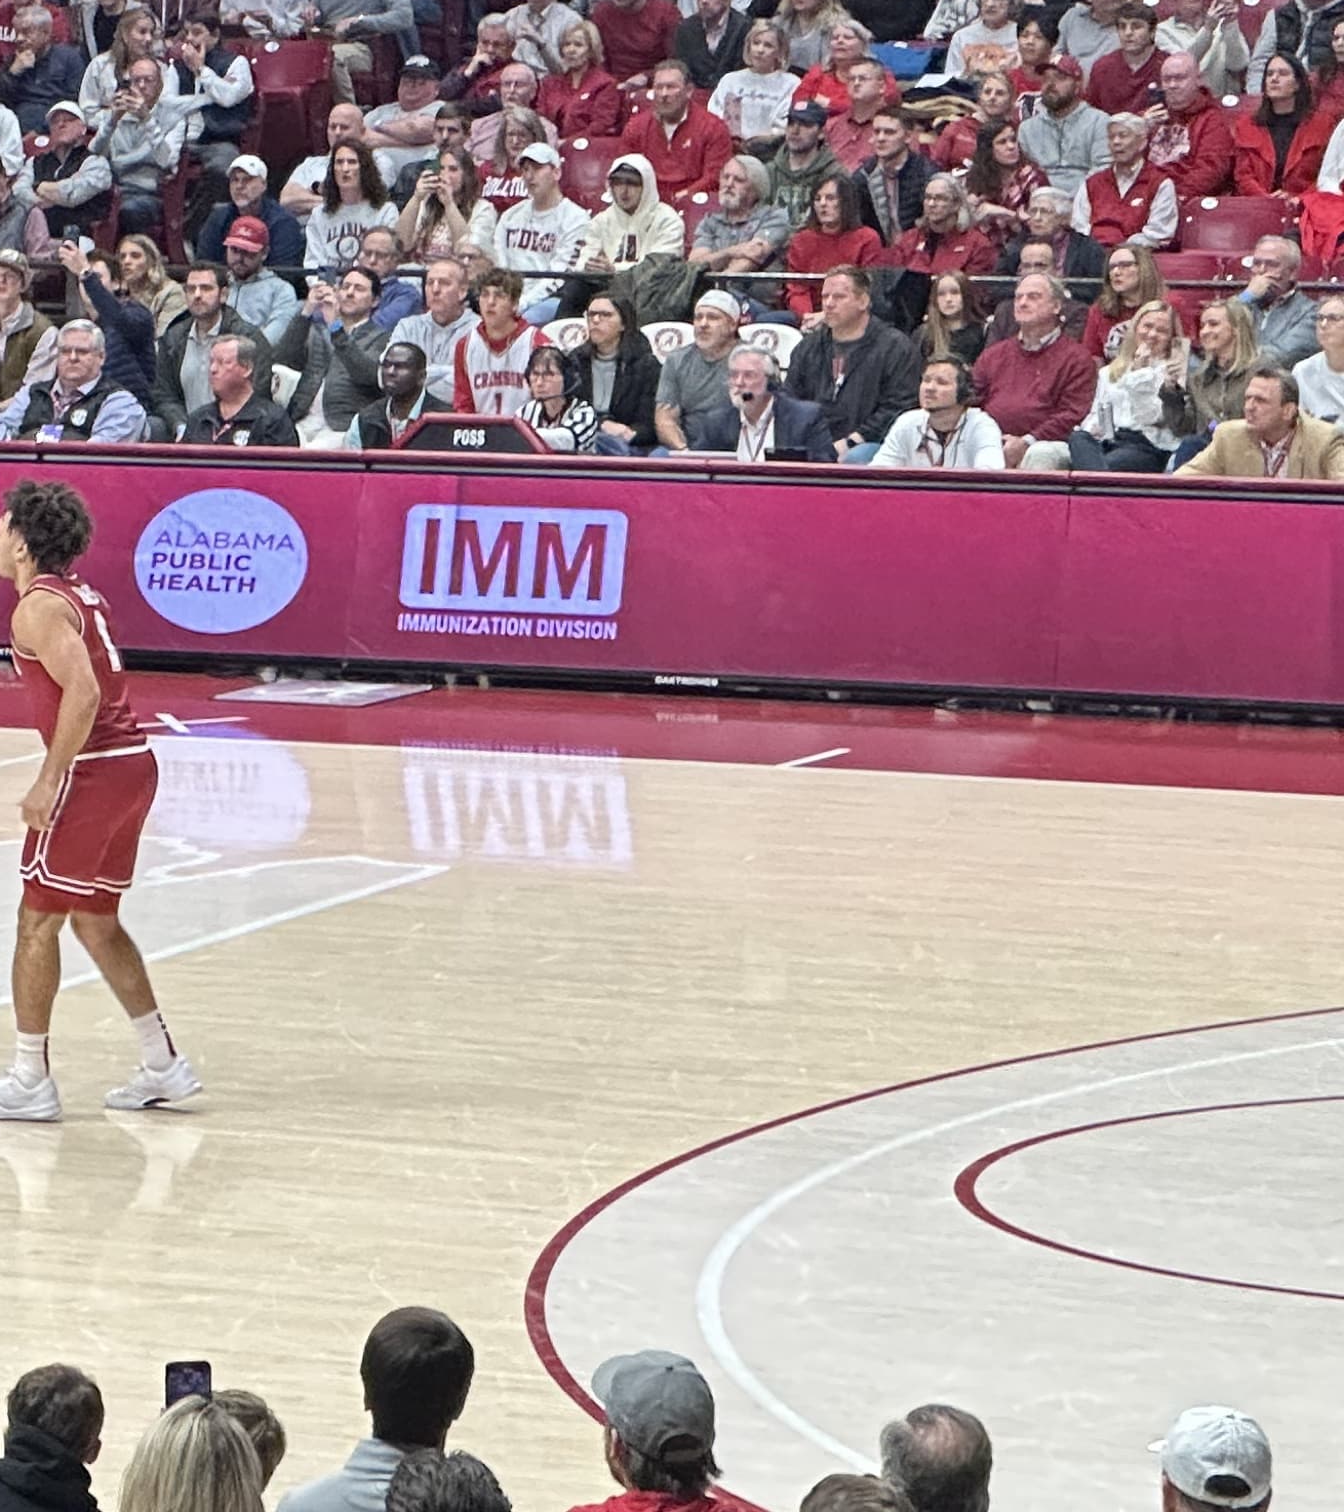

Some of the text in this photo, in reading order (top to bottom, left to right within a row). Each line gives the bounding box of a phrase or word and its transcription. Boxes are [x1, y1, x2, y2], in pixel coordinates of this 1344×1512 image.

[452, 428, 486, 447] POSS
[154, 530, 295, 552] ALABAMA
[151, 552, 252, 572] PUBLIC
[419, 518, 608, 601] IMM
[147, 573, 256, 594] HEALTH
[397, 613, 618, 640] IMMUNIZATION DIVISION
